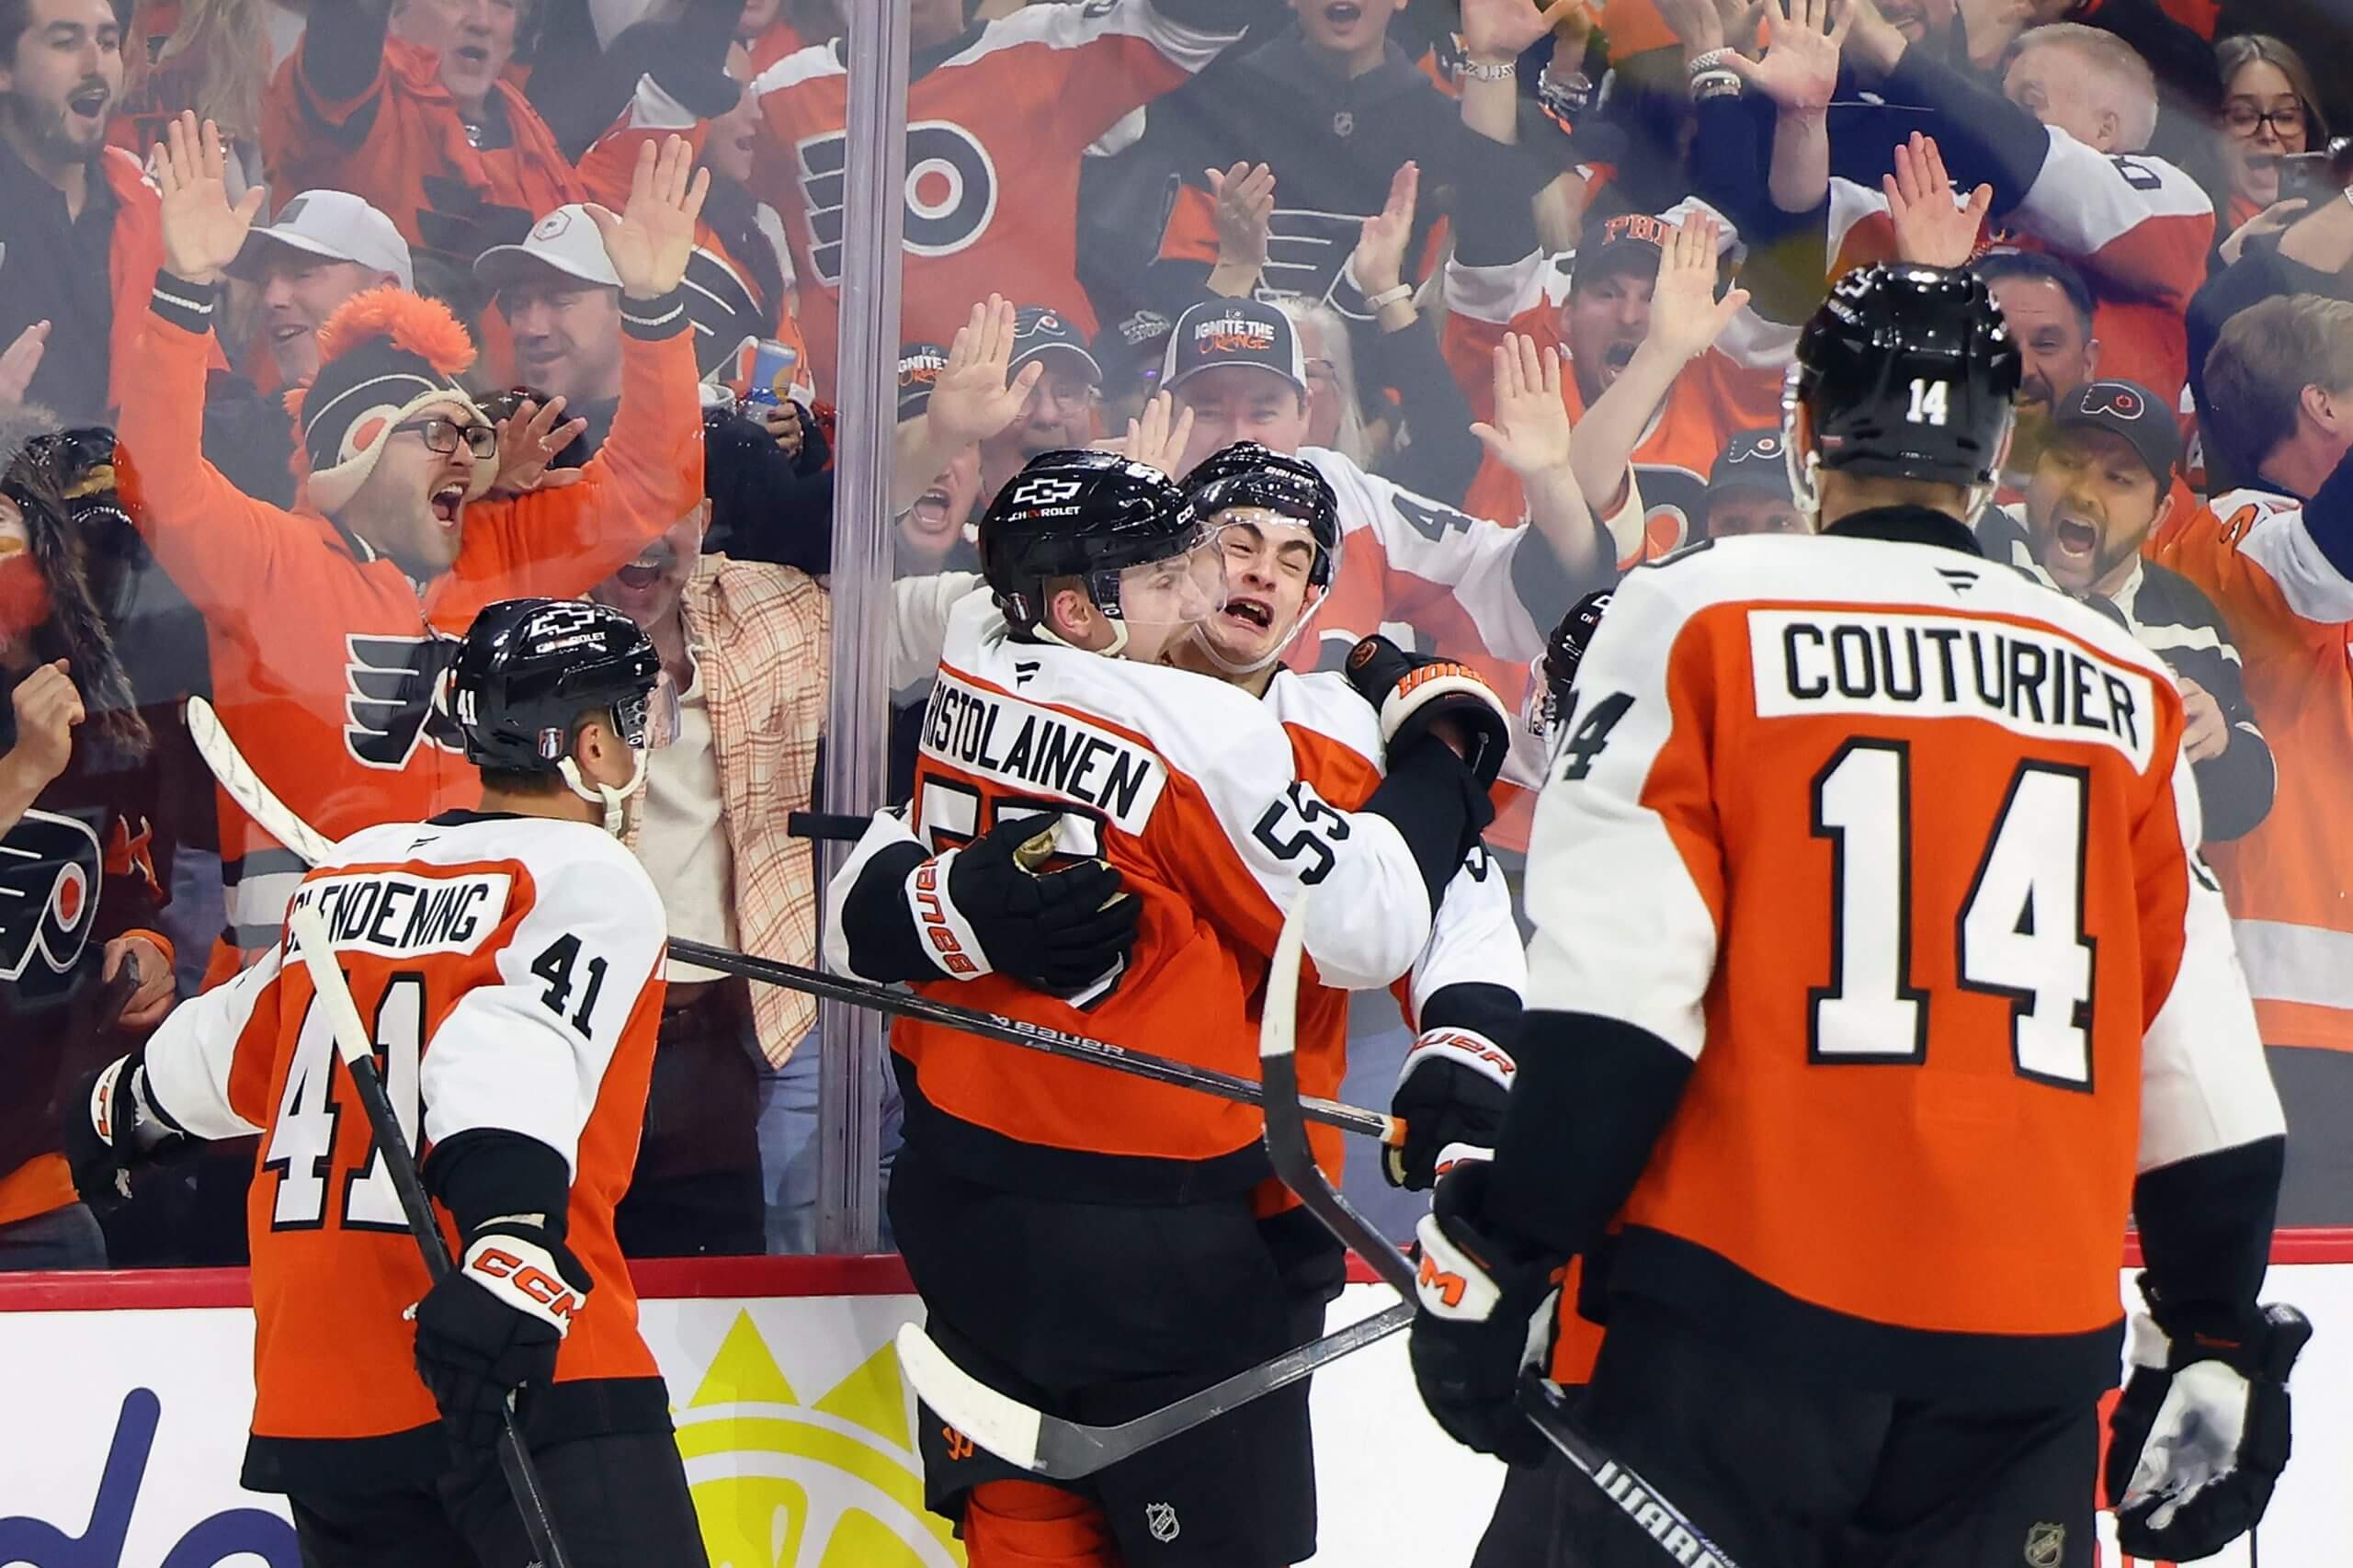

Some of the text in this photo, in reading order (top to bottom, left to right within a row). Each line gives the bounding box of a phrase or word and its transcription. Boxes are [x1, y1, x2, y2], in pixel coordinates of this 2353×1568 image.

[897, 355, 943, 373] GNITE
[1194, 319, 1245, 340] IGNITE
[1245, 321, 1276, 342] THE
[1199, 331, 1271, 354] ORANGE
[1905, 378, 1949, 426] 14
[457, 688, 478, 726] 41
[1783, 623, 2140, 752] COUTURIER
[1252, 778, 1352, 887] 55
[1806, 734, 2098, 1095] 14
[530, 931, 608, 1041] 41
[262, 969, 426, 1232] 41
